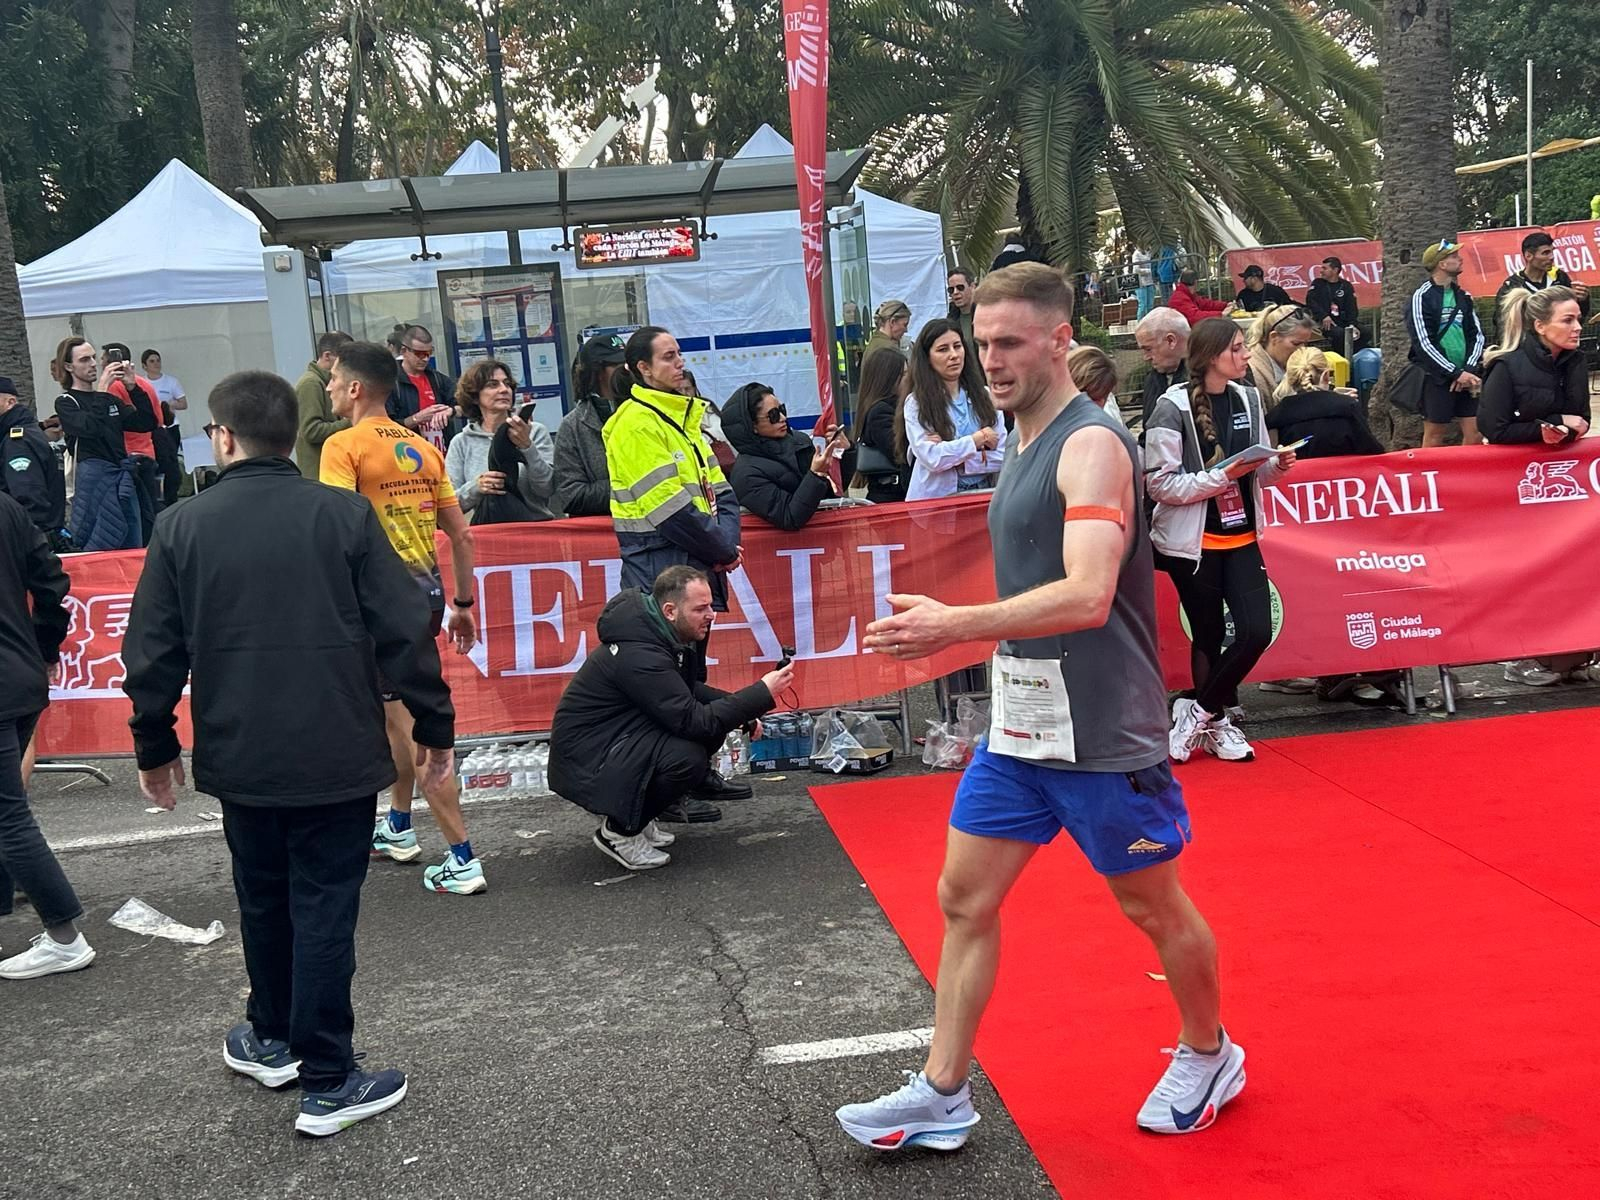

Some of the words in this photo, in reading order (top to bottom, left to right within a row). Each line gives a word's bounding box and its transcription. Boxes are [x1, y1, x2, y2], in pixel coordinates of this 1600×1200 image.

[612, 231, 642, 242] Navidad
[1553, 234, 1586, 247] RATÓN
[592, 243, 612, 251] cada
[641, 239, 650, 248] de
[607, 251, 616, 259] La
[1504, 246, 1597, 276] MAGA
[1261, 470, 1444, 527] NERALI
[1381, 614, 1422, 628] Ciudad
[1383, 629, 1398, 640] de
[1400, 625, 1442, 640] Málaga
